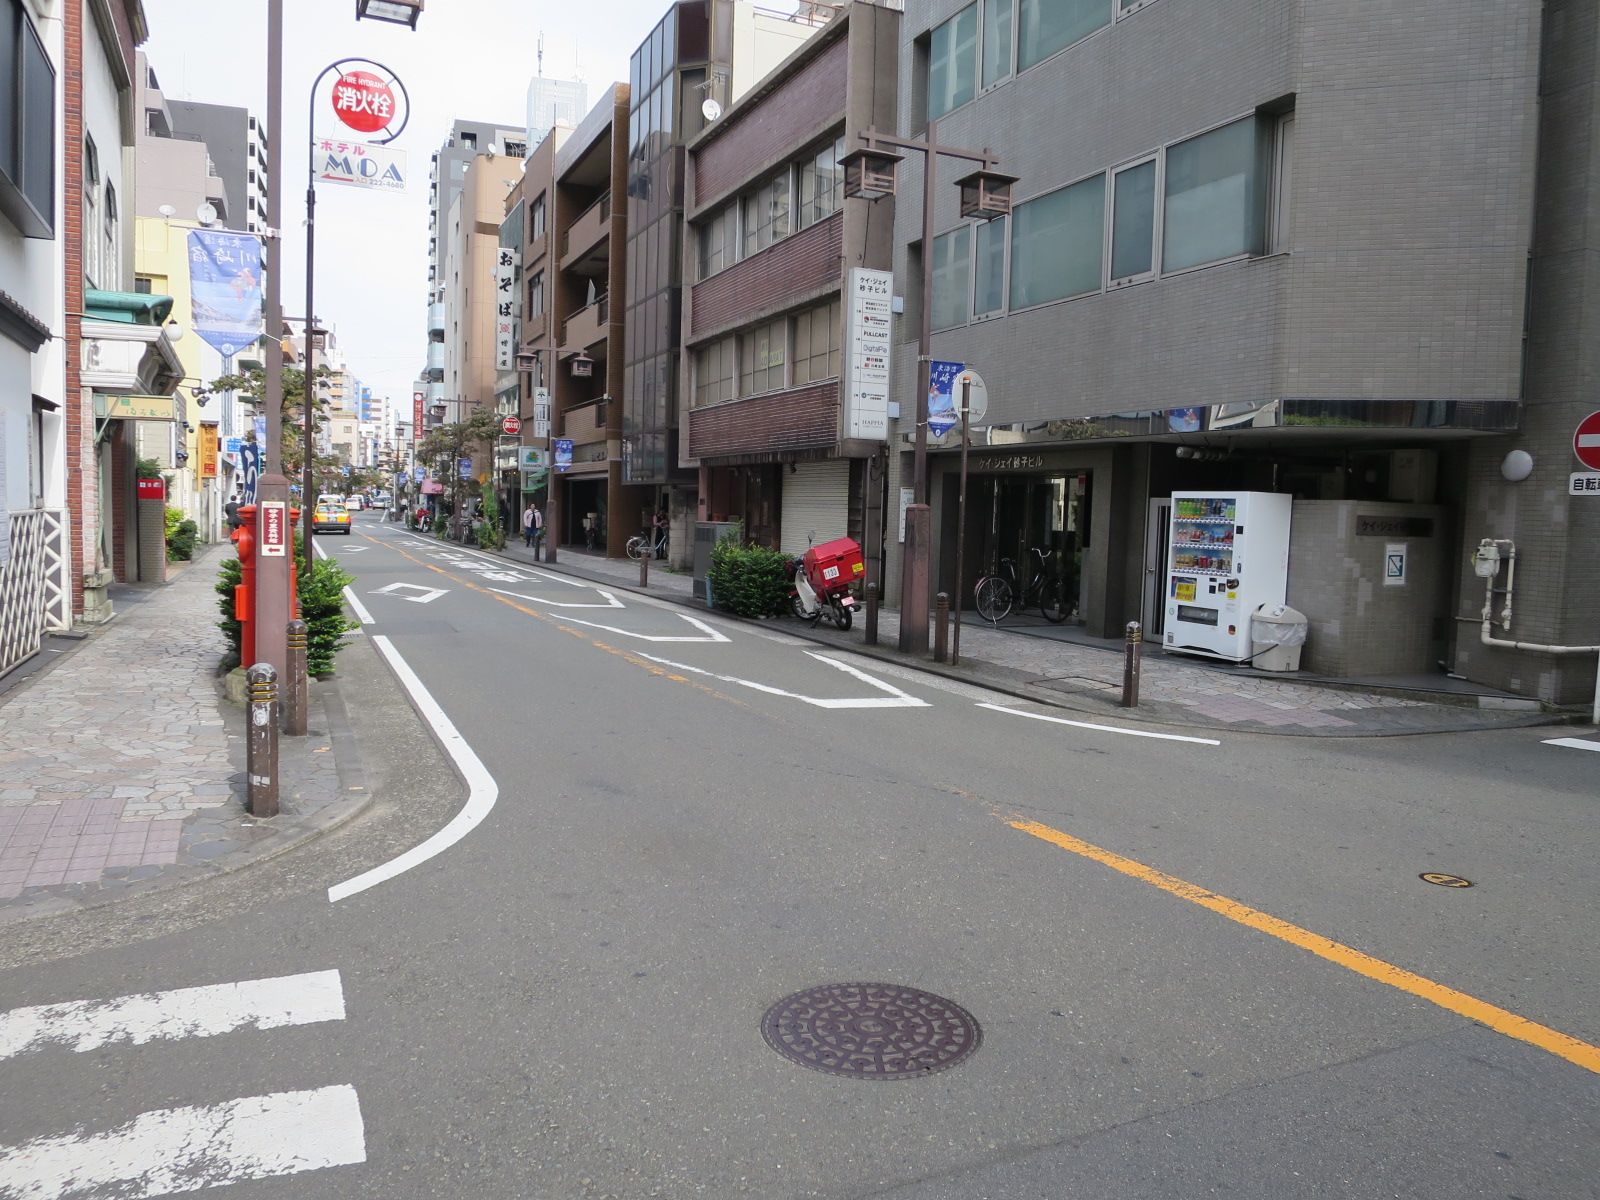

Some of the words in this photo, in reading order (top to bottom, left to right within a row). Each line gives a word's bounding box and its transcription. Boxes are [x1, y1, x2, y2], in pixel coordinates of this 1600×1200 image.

[343, 75, 357, 85] FIRE
[358, 78, 386, 90] HYDRANT
[337, 86, 391, 118] 消火栓
[320, 141, 365, 156] ホテル
[324, 154, 404, 182] MOA
[499, 251, 513, 317] おそば
[860, 285, 888, 295] 砂子ビル
[863, 330, 889, 339] FULLCAST
[1573, 477, 1600, 491] 自転
